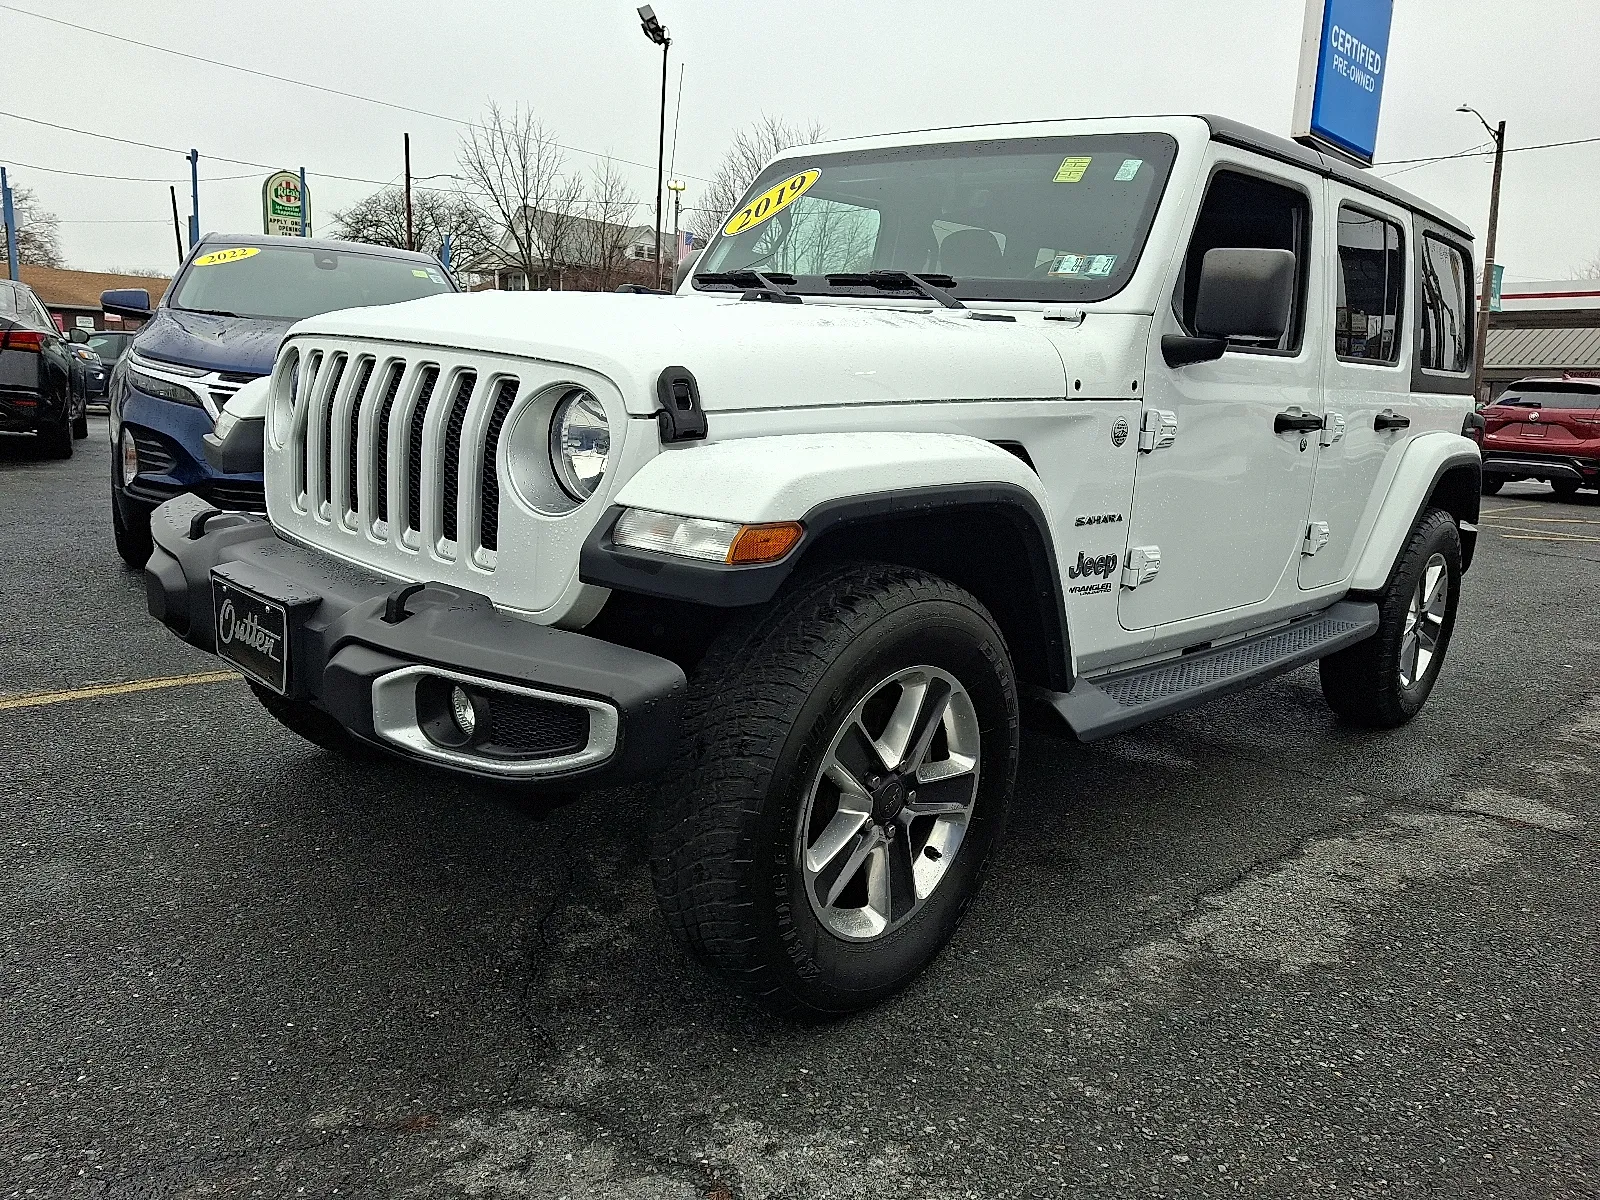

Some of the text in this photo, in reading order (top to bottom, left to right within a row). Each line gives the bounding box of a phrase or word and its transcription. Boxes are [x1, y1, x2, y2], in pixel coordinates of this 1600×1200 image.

[1331, 25, 1381, 75] CERTIFIED
[1332, 54, 1375, 93] PRE-OWNED
[737, 175, 806, 231] 2019
[269, 217, 288, 225] APPLY
[207, 248, 248, 263] 2022
[1075, 513, 1123, 526] SAHARA
[1068, 551, 1118, 579] Jeep
[1068, 582, 1112, 594] WRANGLER
[220, 599, 281, 662] Outten
